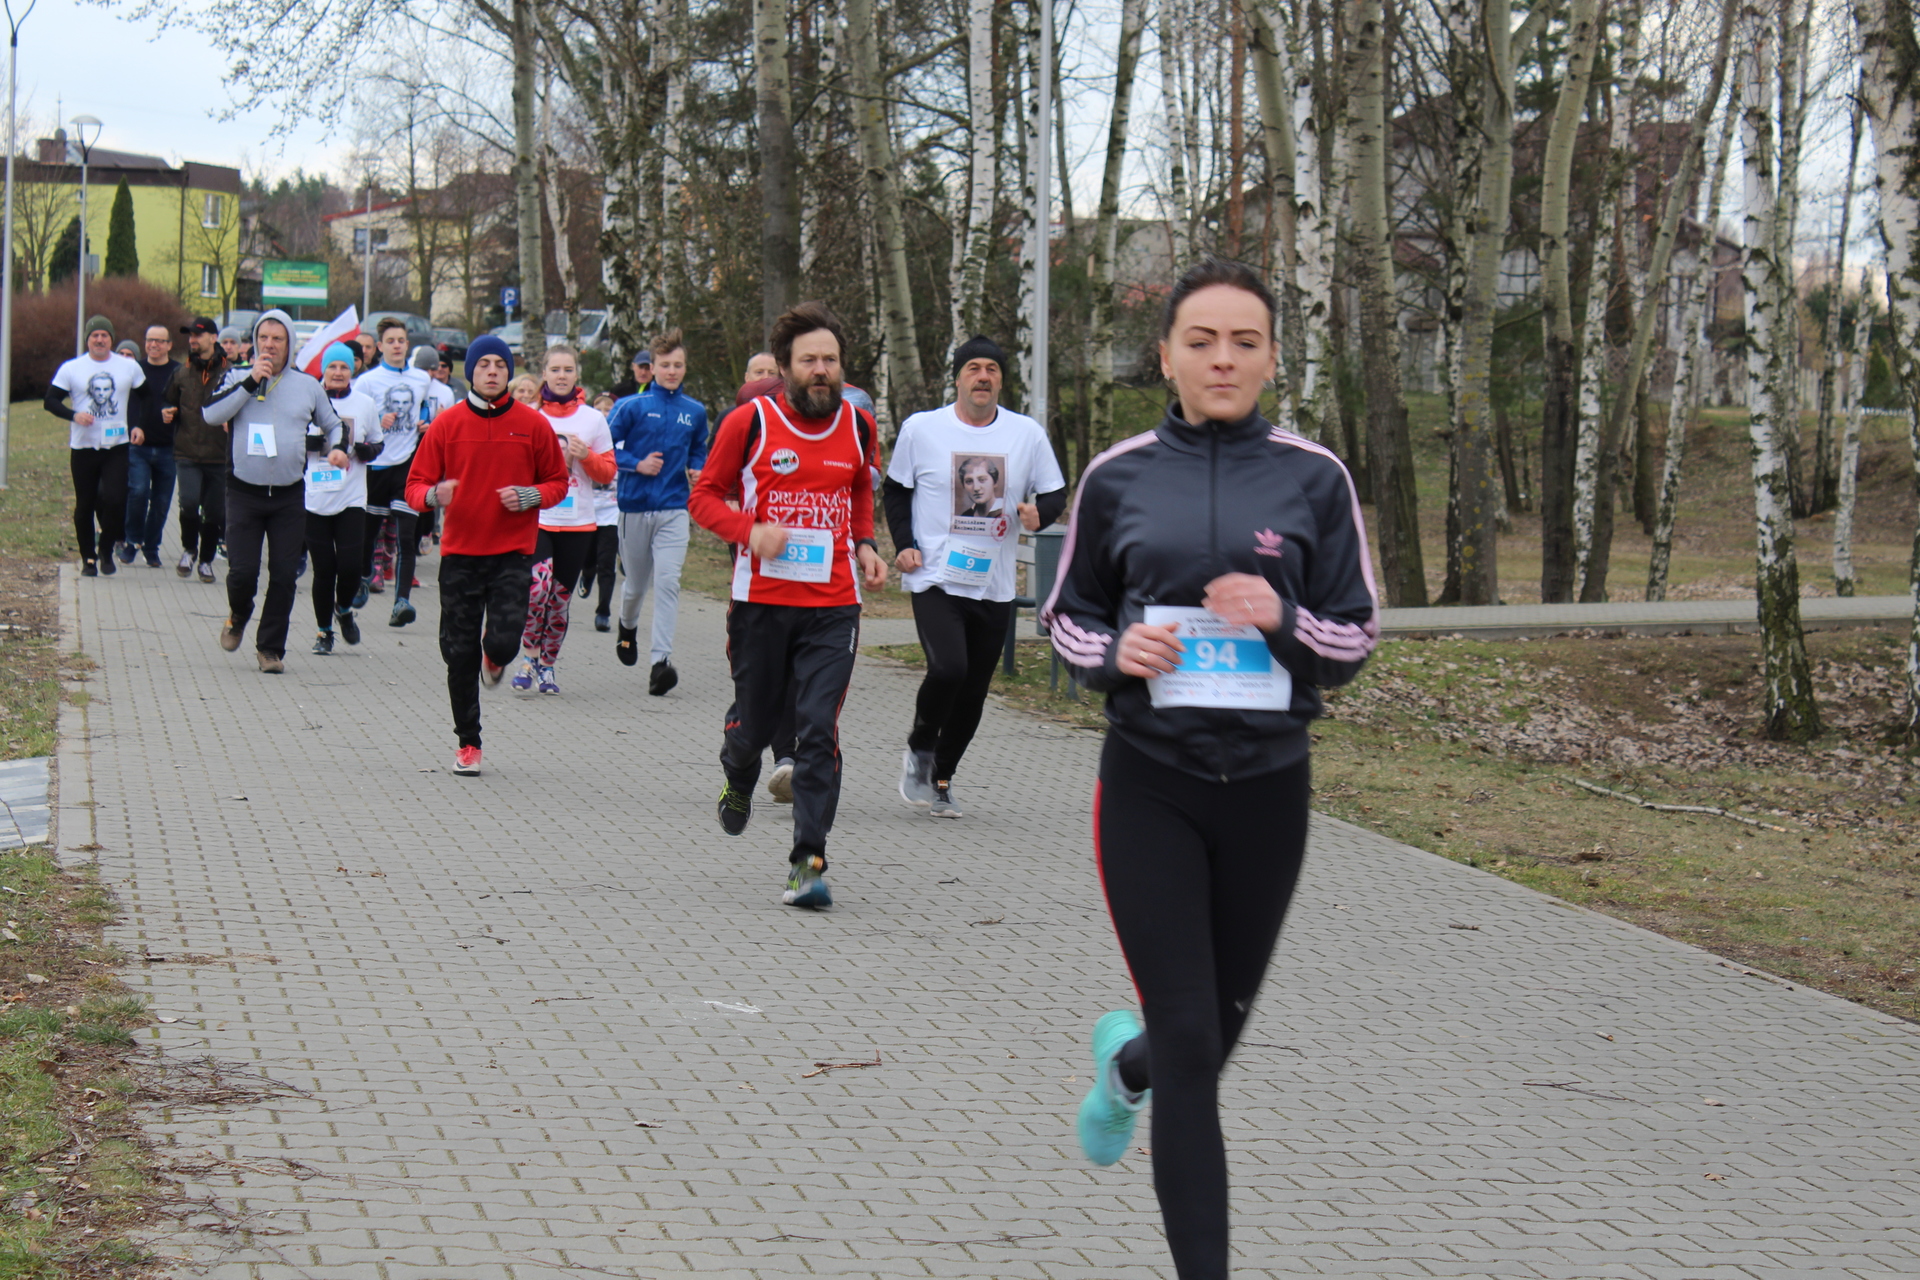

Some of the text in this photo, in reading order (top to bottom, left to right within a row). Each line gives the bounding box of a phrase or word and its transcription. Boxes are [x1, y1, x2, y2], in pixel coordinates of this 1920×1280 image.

[504, 289, 515, 305] P
[320, 471, 333, 481] 29
[767, 488, 839, 508] DRUŻYNA
[767, 505, 845, 529] SZPIKU
[787, 545, 809, 562] 93
[965, 557, 976, 570] 9
[1194, 640, 1240, 671] 94
